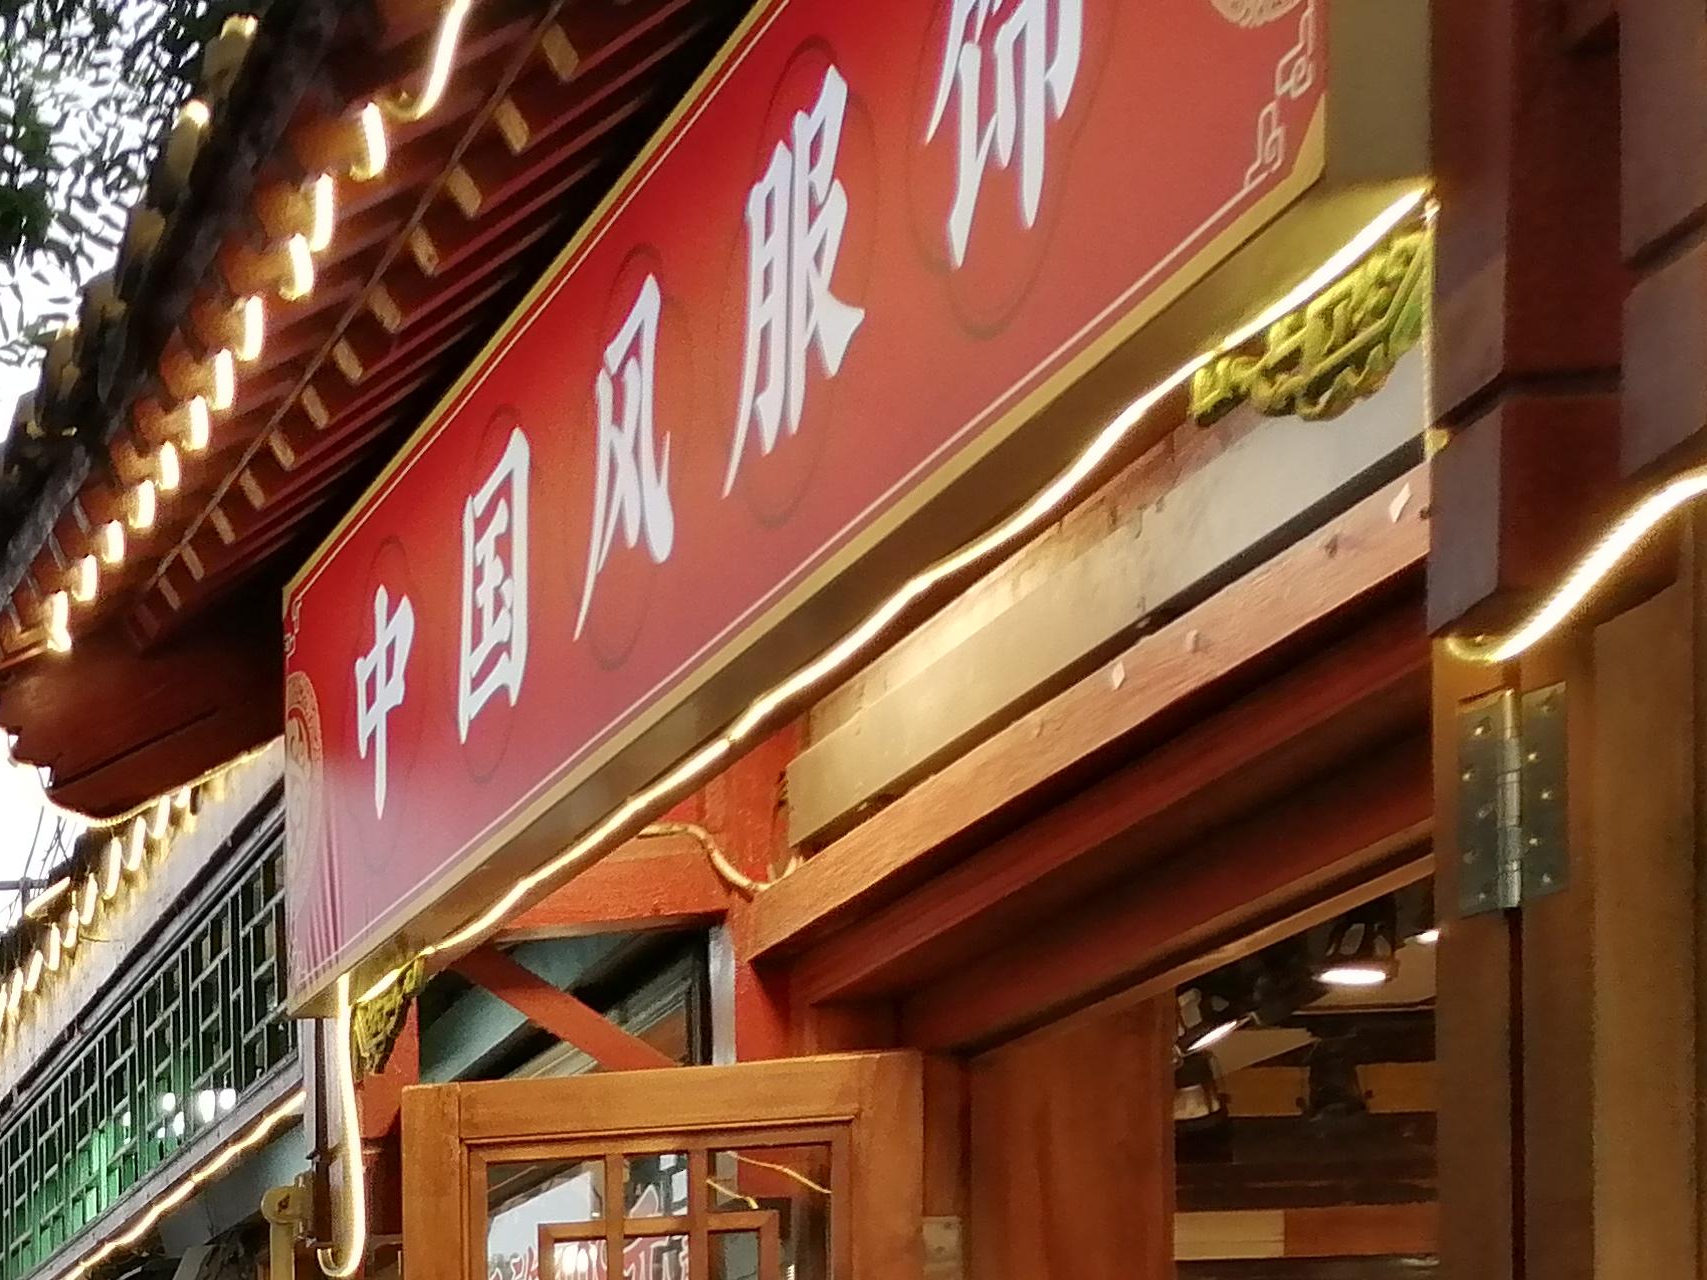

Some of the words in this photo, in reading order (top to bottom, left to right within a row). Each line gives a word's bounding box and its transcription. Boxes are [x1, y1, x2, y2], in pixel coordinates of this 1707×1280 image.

[353, 0, 1085, 822] 中国风服饰
